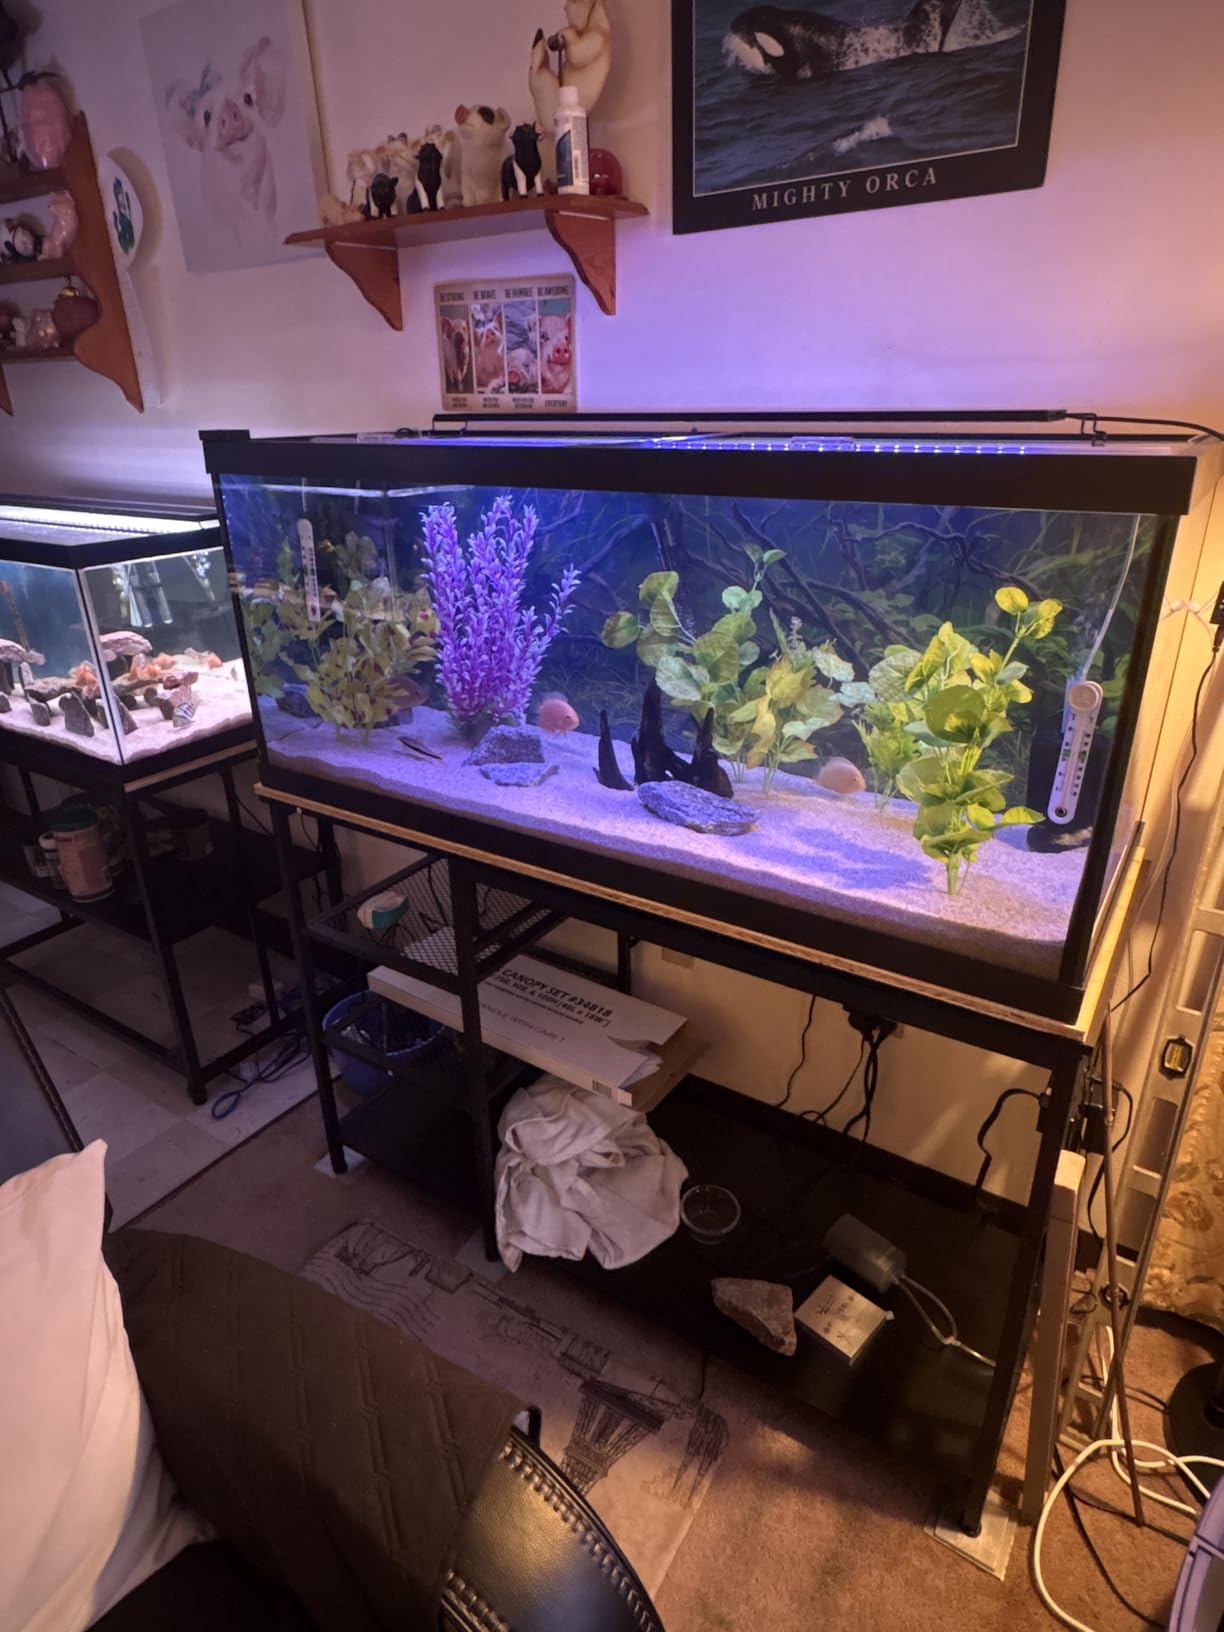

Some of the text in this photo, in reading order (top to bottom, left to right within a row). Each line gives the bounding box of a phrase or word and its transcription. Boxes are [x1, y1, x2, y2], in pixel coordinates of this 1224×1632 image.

[752, 167, 937, 211] MIGHTY ORCA
[501, 969, 549, 990] CANOPY
[544, 987, 570, 999] SET
[567, 996, 613, 1017] #34818
